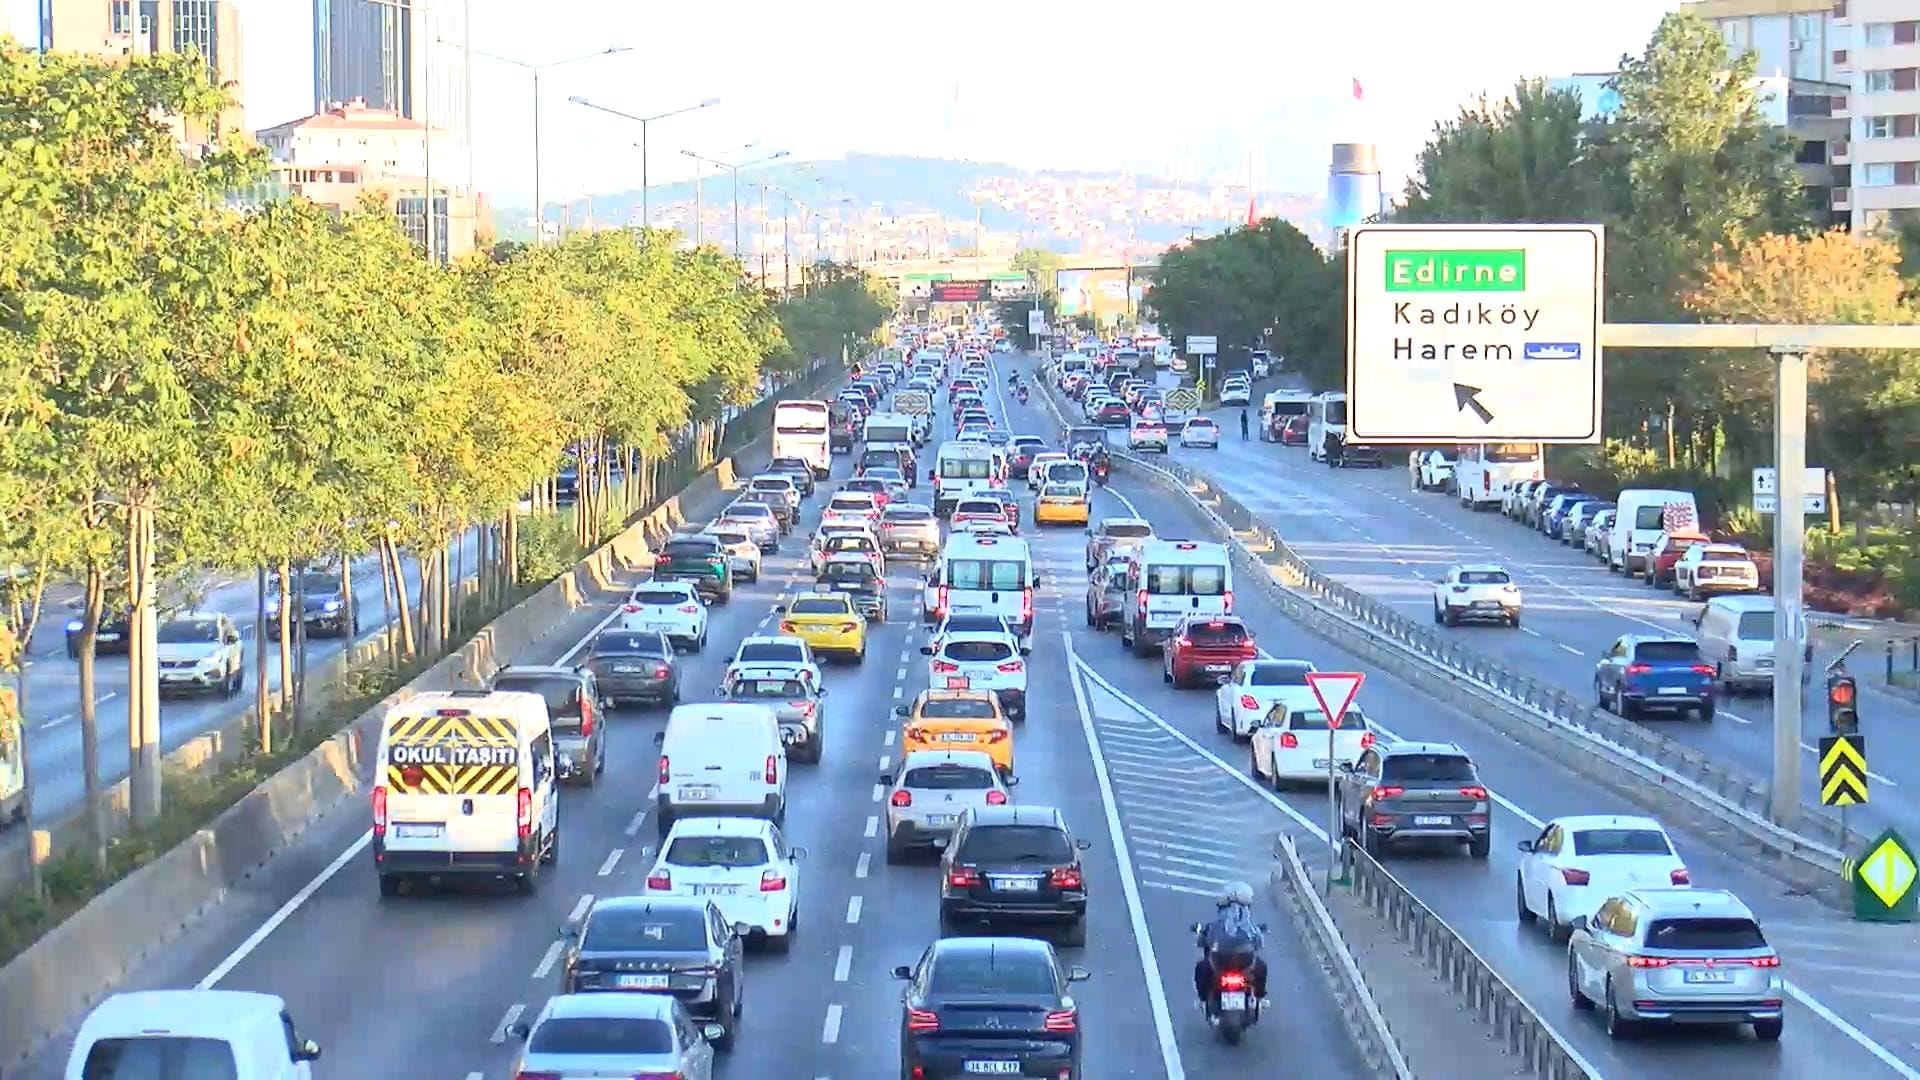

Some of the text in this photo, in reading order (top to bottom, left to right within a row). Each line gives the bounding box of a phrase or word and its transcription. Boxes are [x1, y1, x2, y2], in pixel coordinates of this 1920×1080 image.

[1392, 258, 1518, 285] Edirne
[1394, 301, 1541, 331] Kadıköy
[1393, 337, 1513, 360] Harem
[393, 745, 516, 768] OKUL TAŞITI
